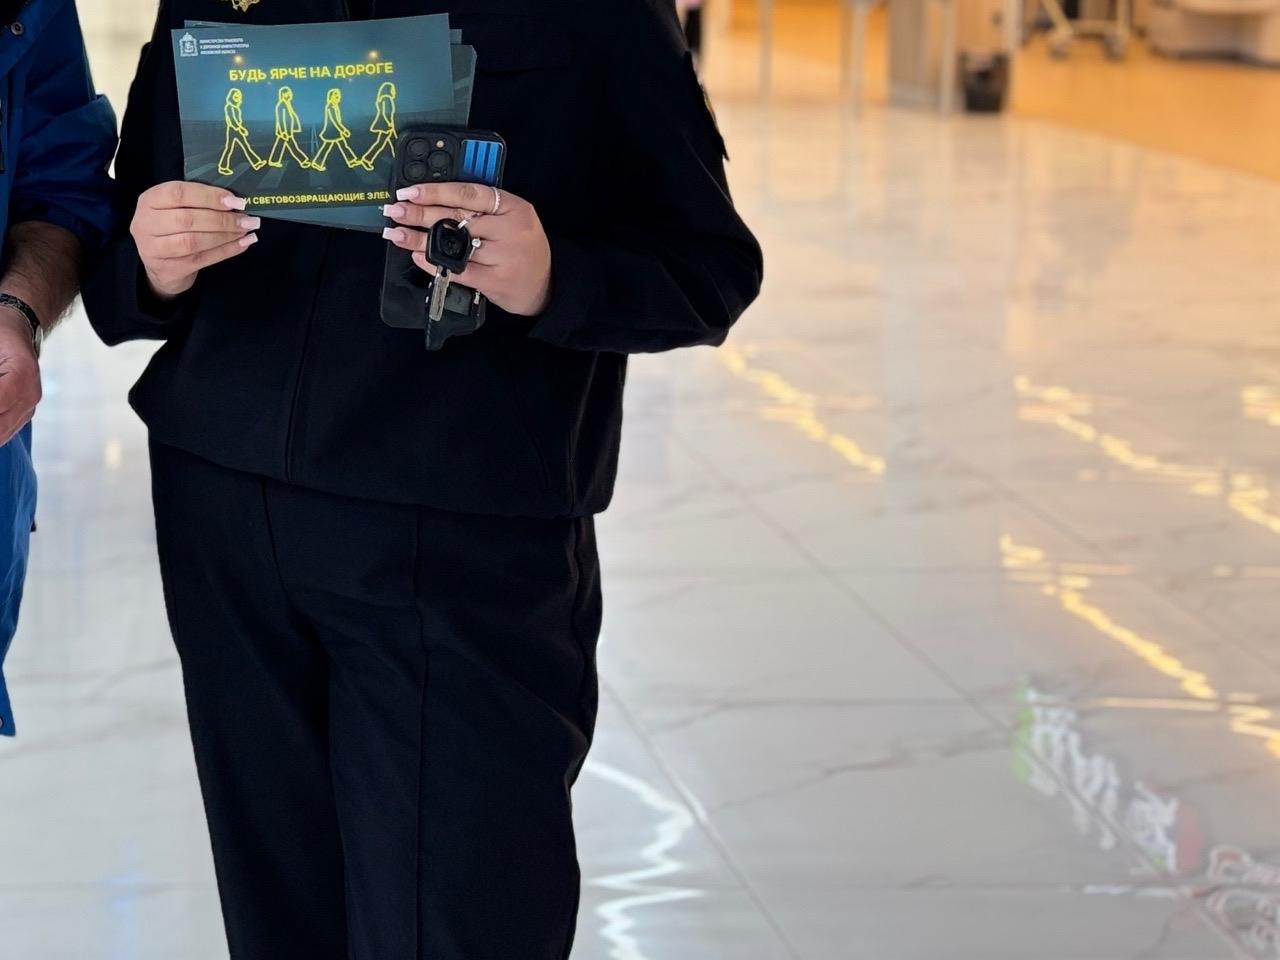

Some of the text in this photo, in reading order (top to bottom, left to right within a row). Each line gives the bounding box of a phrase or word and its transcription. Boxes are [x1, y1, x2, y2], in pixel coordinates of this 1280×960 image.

[229, 62, 393, 82] БУДЬ ЯРЧЕ НА ДОРОГЕ
[253, 192, 365, 205] СВЕТОВОЗВРАЩАЮЩИЕ
